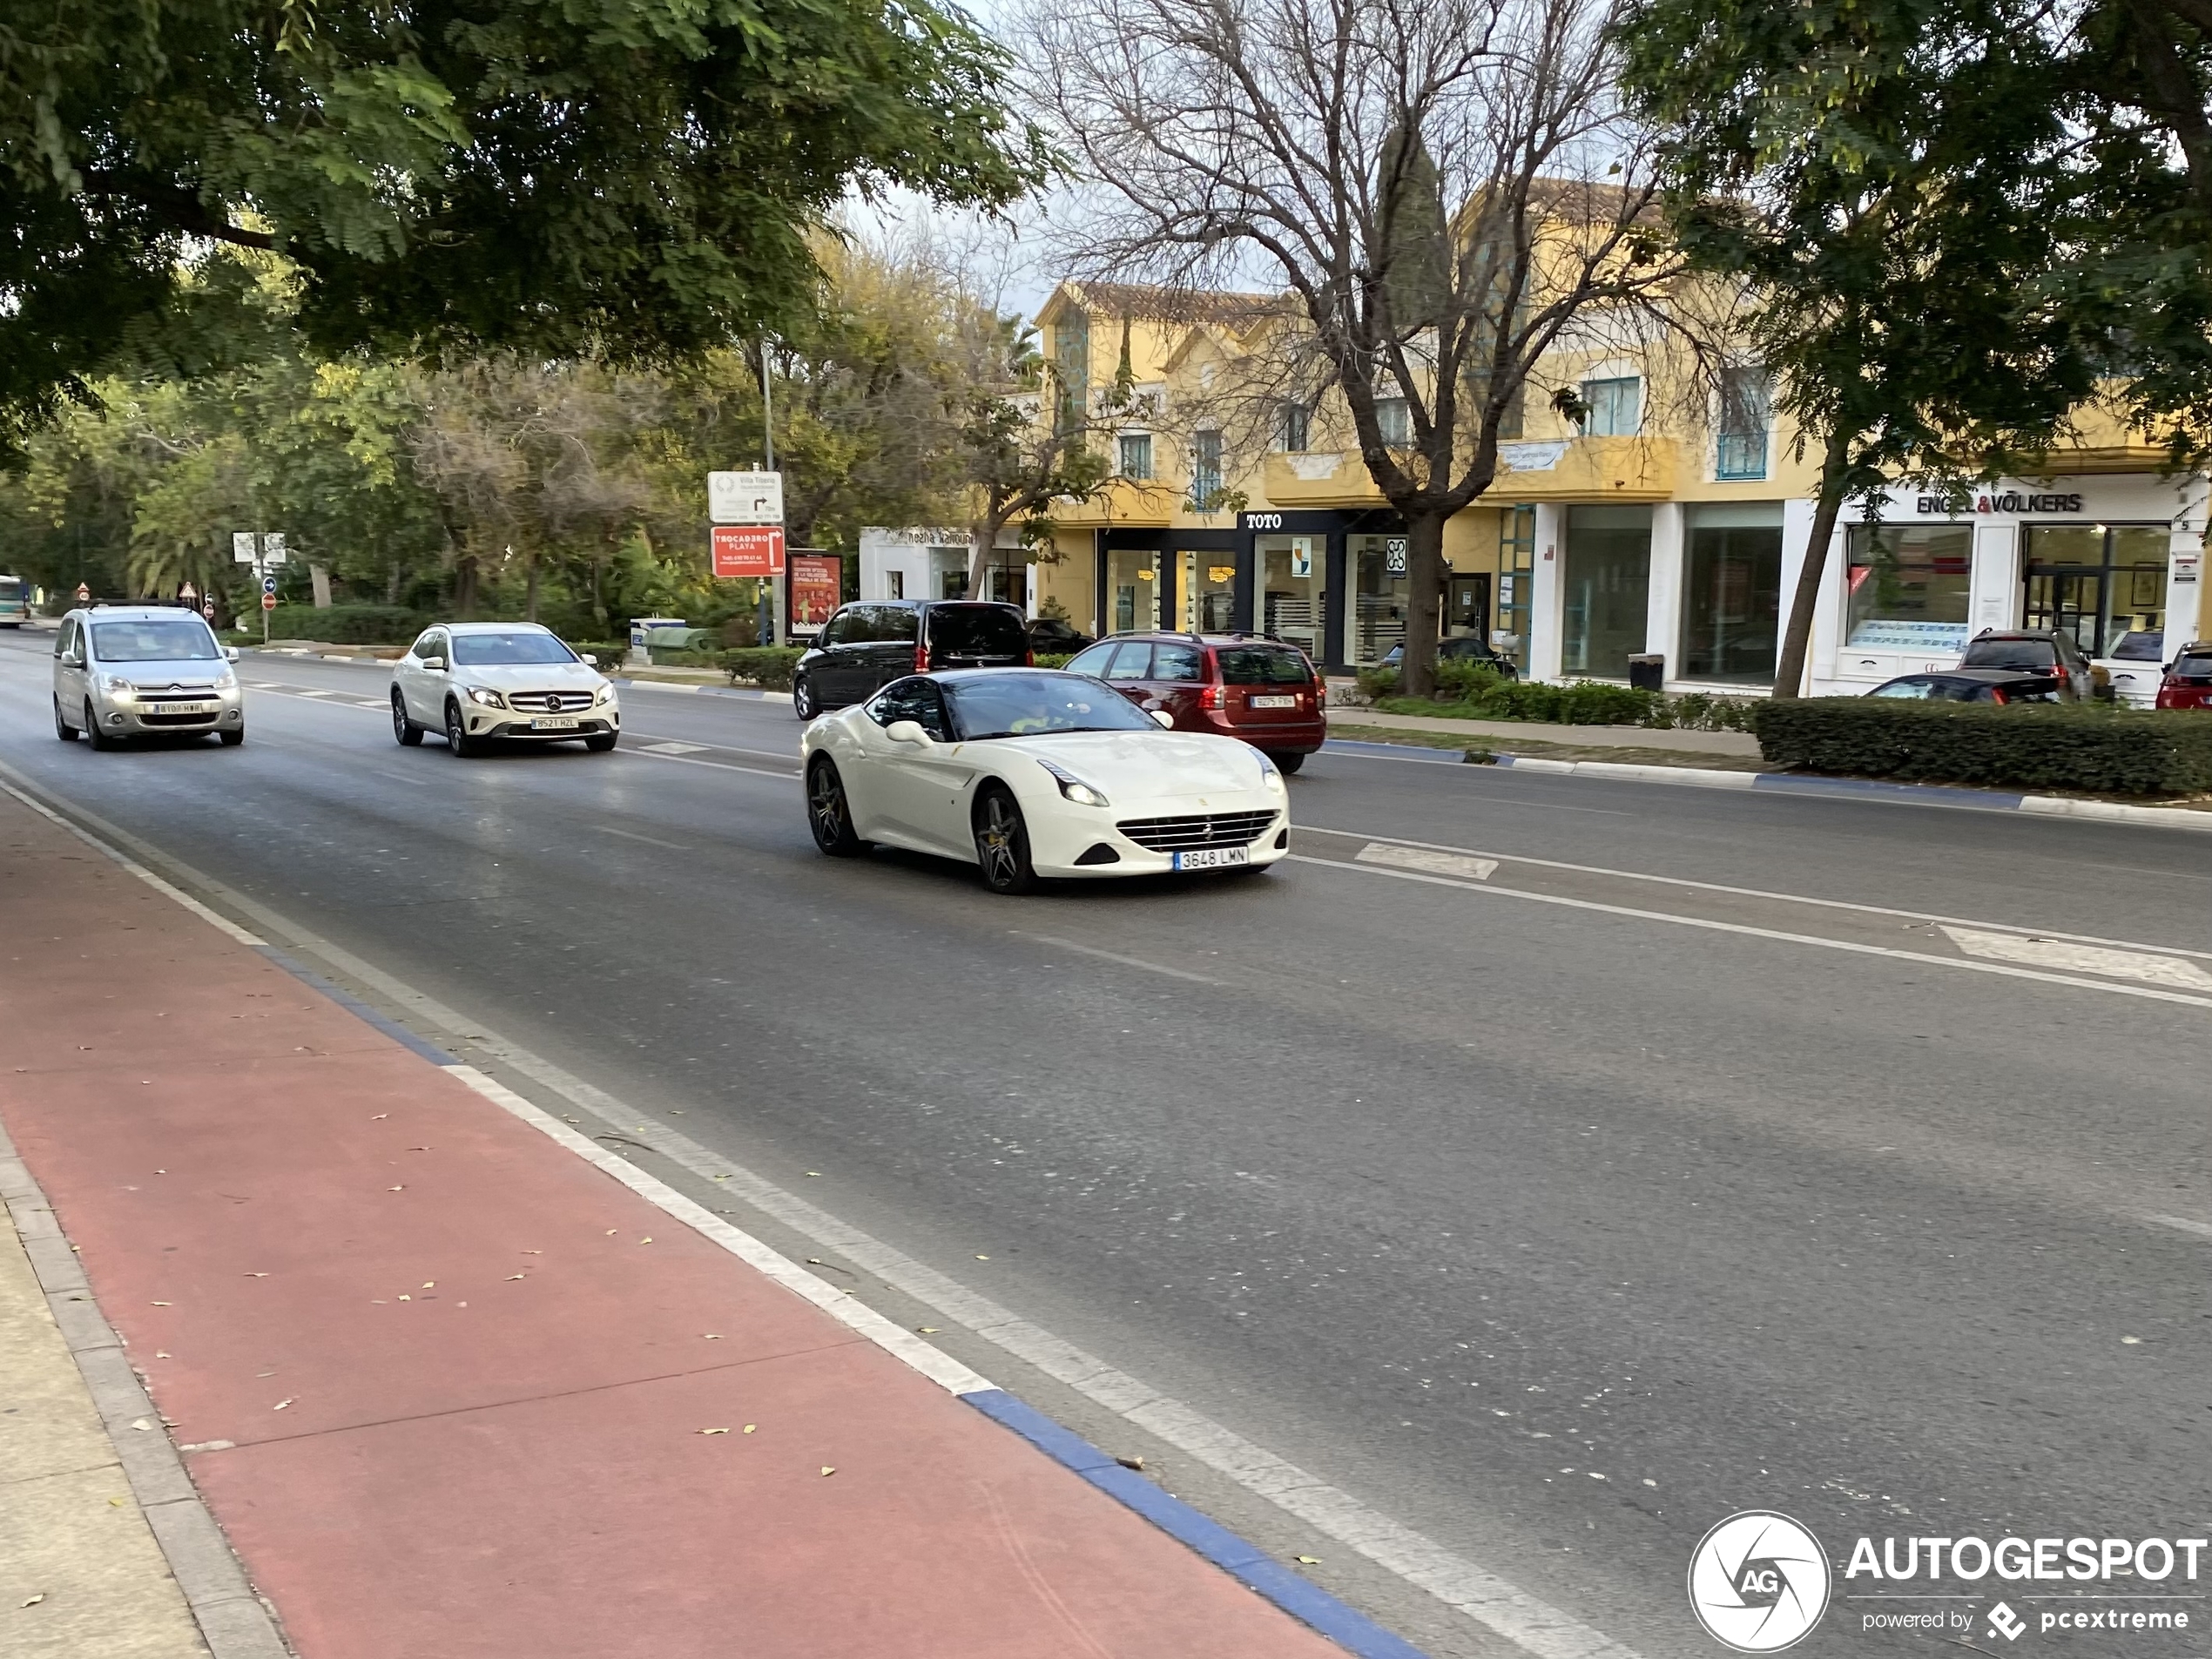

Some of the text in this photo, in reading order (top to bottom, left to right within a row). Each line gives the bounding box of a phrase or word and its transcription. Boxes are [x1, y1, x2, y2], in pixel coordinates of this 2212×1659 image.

[1246, 514, 1282, 529] TOTO
[2182, 520, 2189, 530] 5
[715, 535, 768, 543] TROCADERO
[1184, 848, 1244, 867] 3648 LMN
